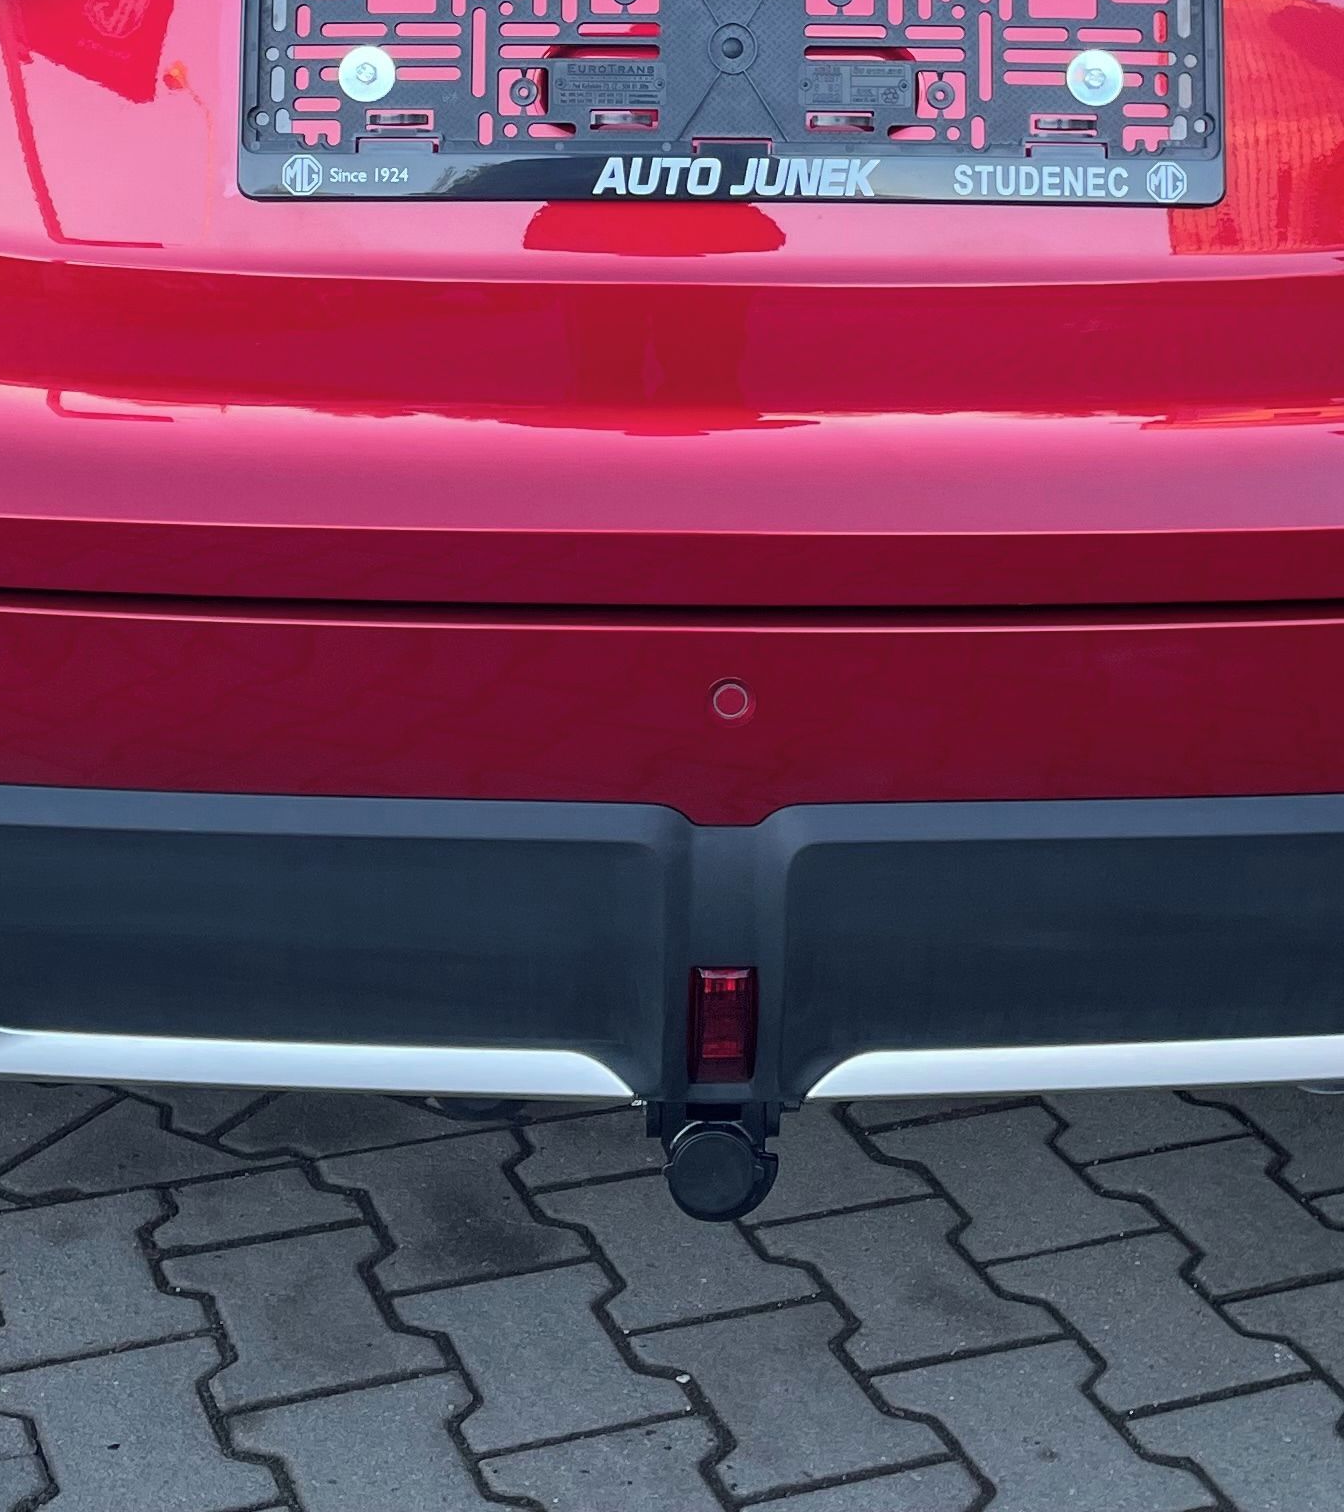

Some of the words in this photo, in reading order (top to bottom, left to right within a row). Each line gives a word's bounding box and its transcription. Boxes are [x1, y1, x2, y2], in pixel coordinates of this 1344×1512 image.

[285, 158, 320, 193] MG
[329, 167, 367, 183] Since
[375, 167, 409, 183] 1924
[592, 157, 721, 196] AUTO
[729, 158, 881, 197] JUNEK
[953, 164, 1129, 198] STUDENEC
[1150, 165, 1184, 200] MG
